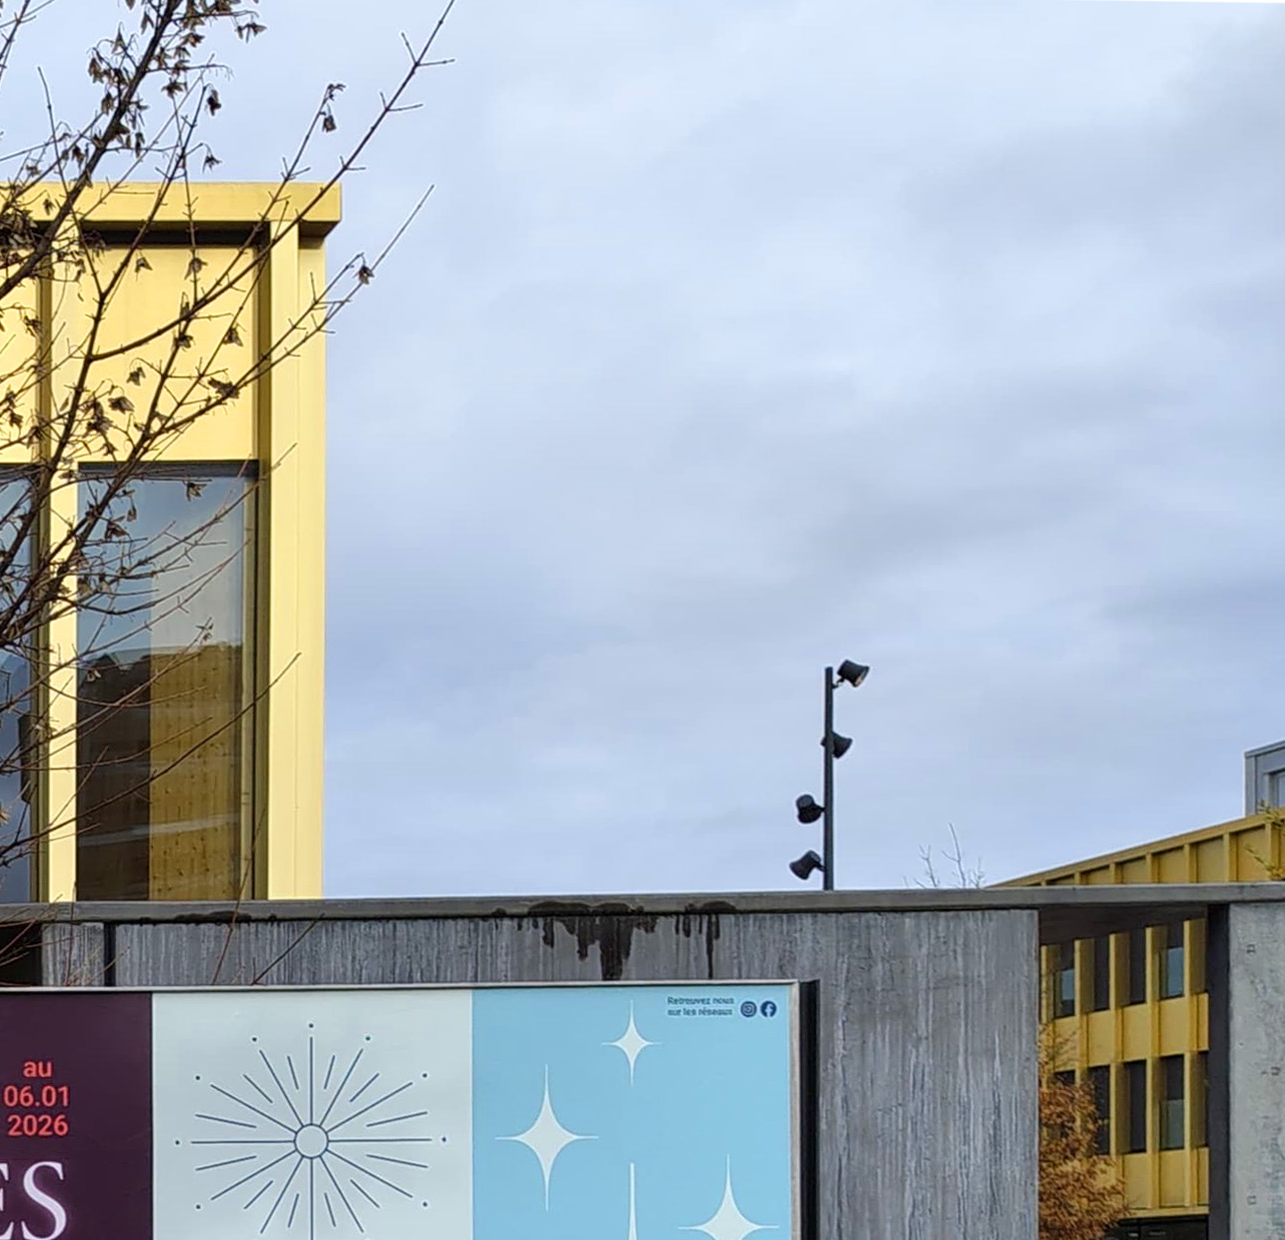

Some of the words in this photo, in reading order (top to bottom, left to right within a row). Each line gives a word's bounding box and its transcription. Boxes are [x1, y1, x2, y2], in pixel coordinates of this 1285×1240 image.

[668, 1008, 684, 1016] sur
[683, 1008, 696, 1016] les
[699, 1007, 732, 1015] réseaux
[23, 1062, 51, 1077] au
[4, 1086, 68, 1106] 06.01
[8, 1115, 68, 1136] 2026
